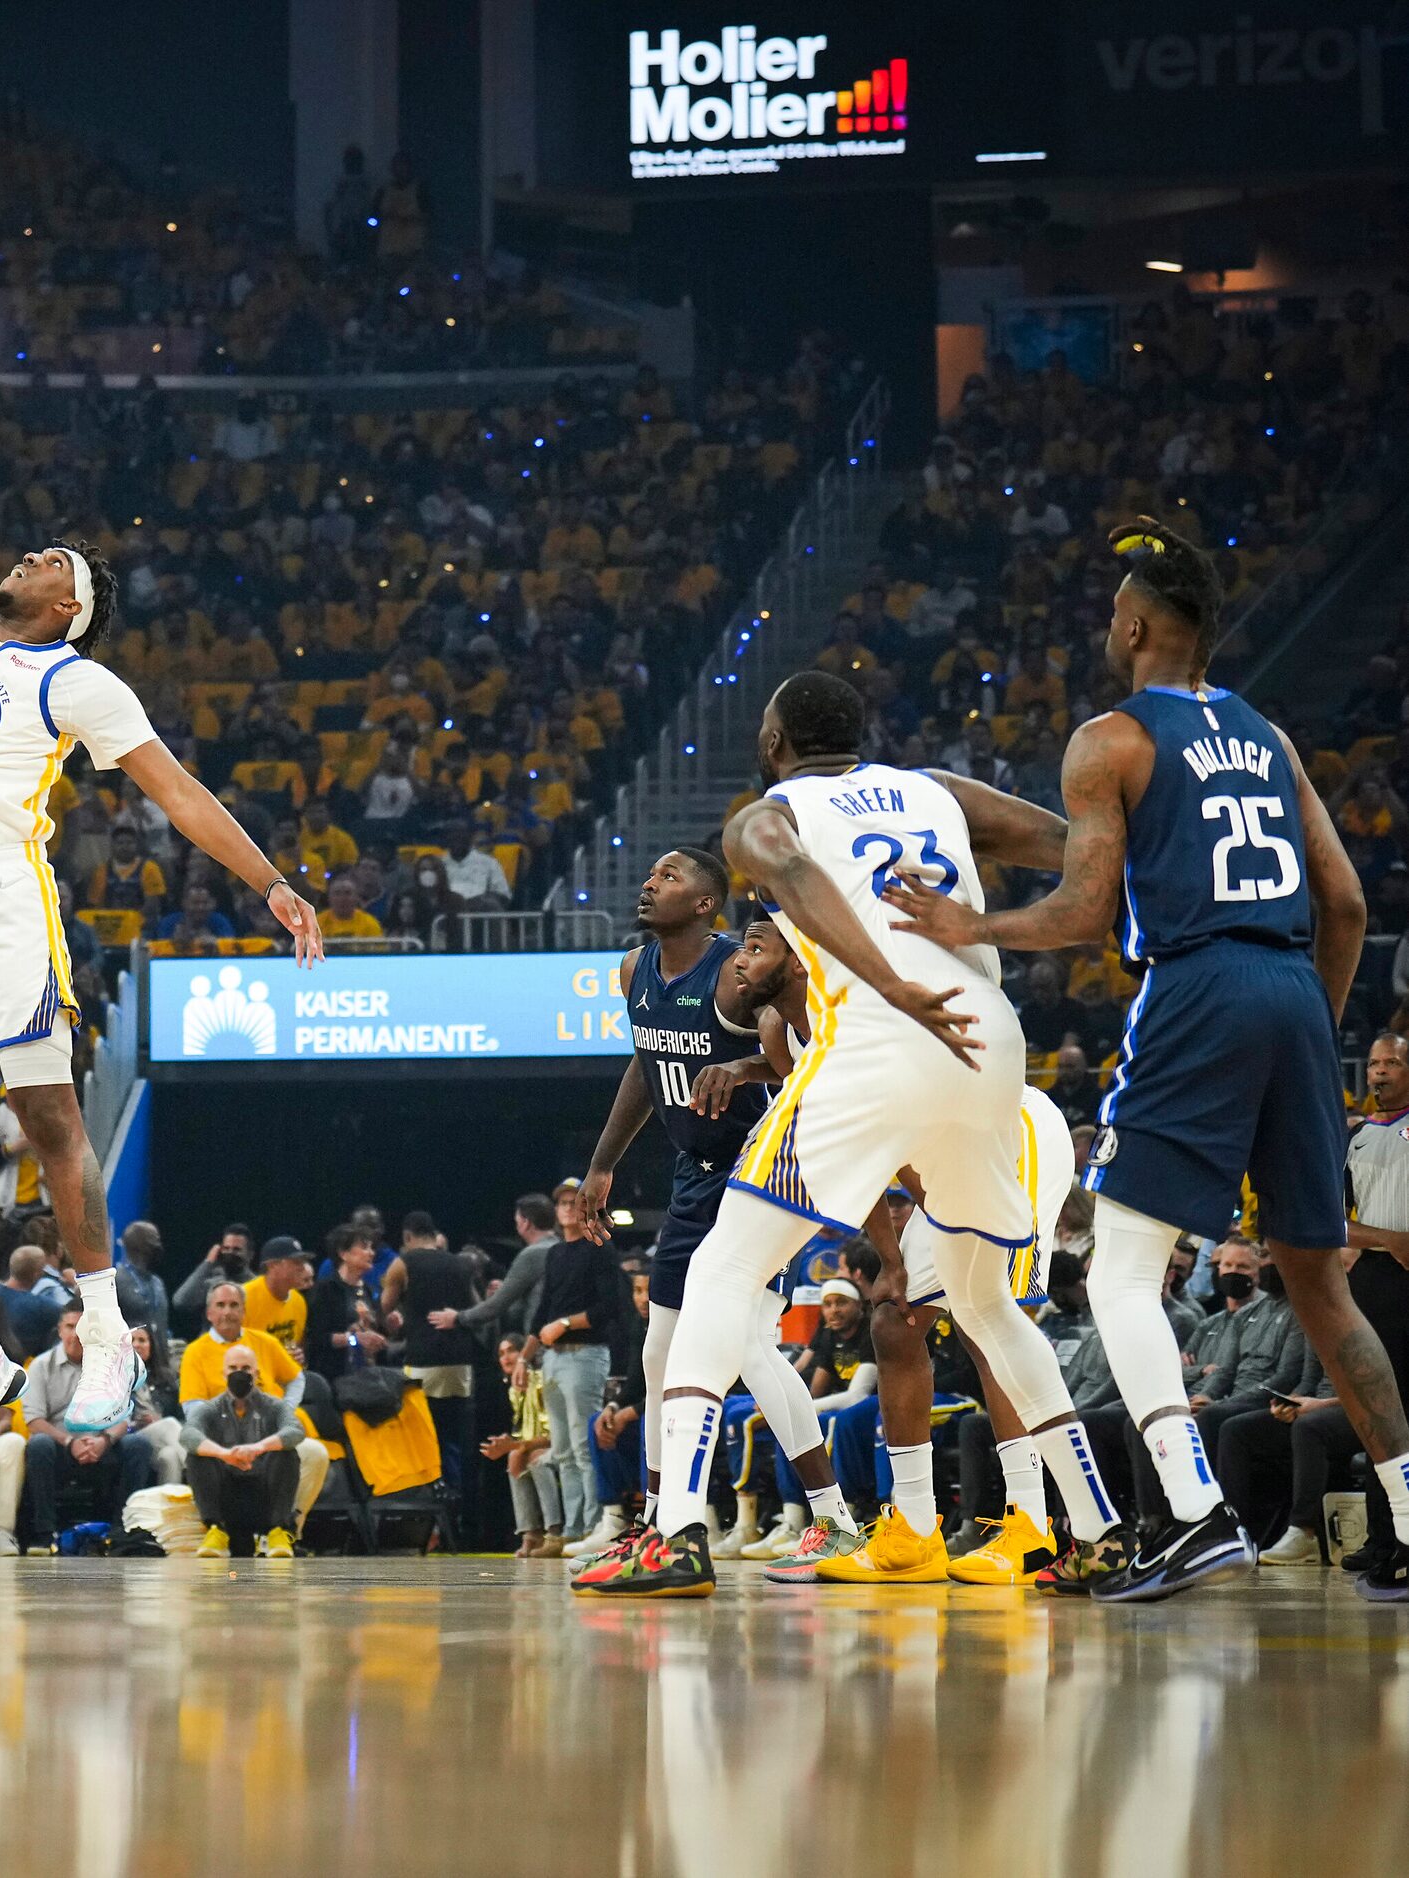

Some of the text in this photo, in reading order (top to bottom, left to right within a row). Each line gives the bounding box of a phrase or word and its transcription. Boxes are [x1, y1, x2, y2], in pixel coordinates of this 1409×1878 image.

[630, 25, 827, 88] Holier
[10, 654, 41, 671] Rakuten
[1182, 736, 1273, 783] BULLOCK
[829, 787, 905, 817] GREEN
[851, 829, 959, 899] 23
[1201, 794, 1301, 902] 25
[295, 989, 390, 1018] KAISER
[676, 995, 702, 1007] chime
[631, 1024, 712, 1056] MAVERICKS
[656, 1059, 692, 1108] 10
